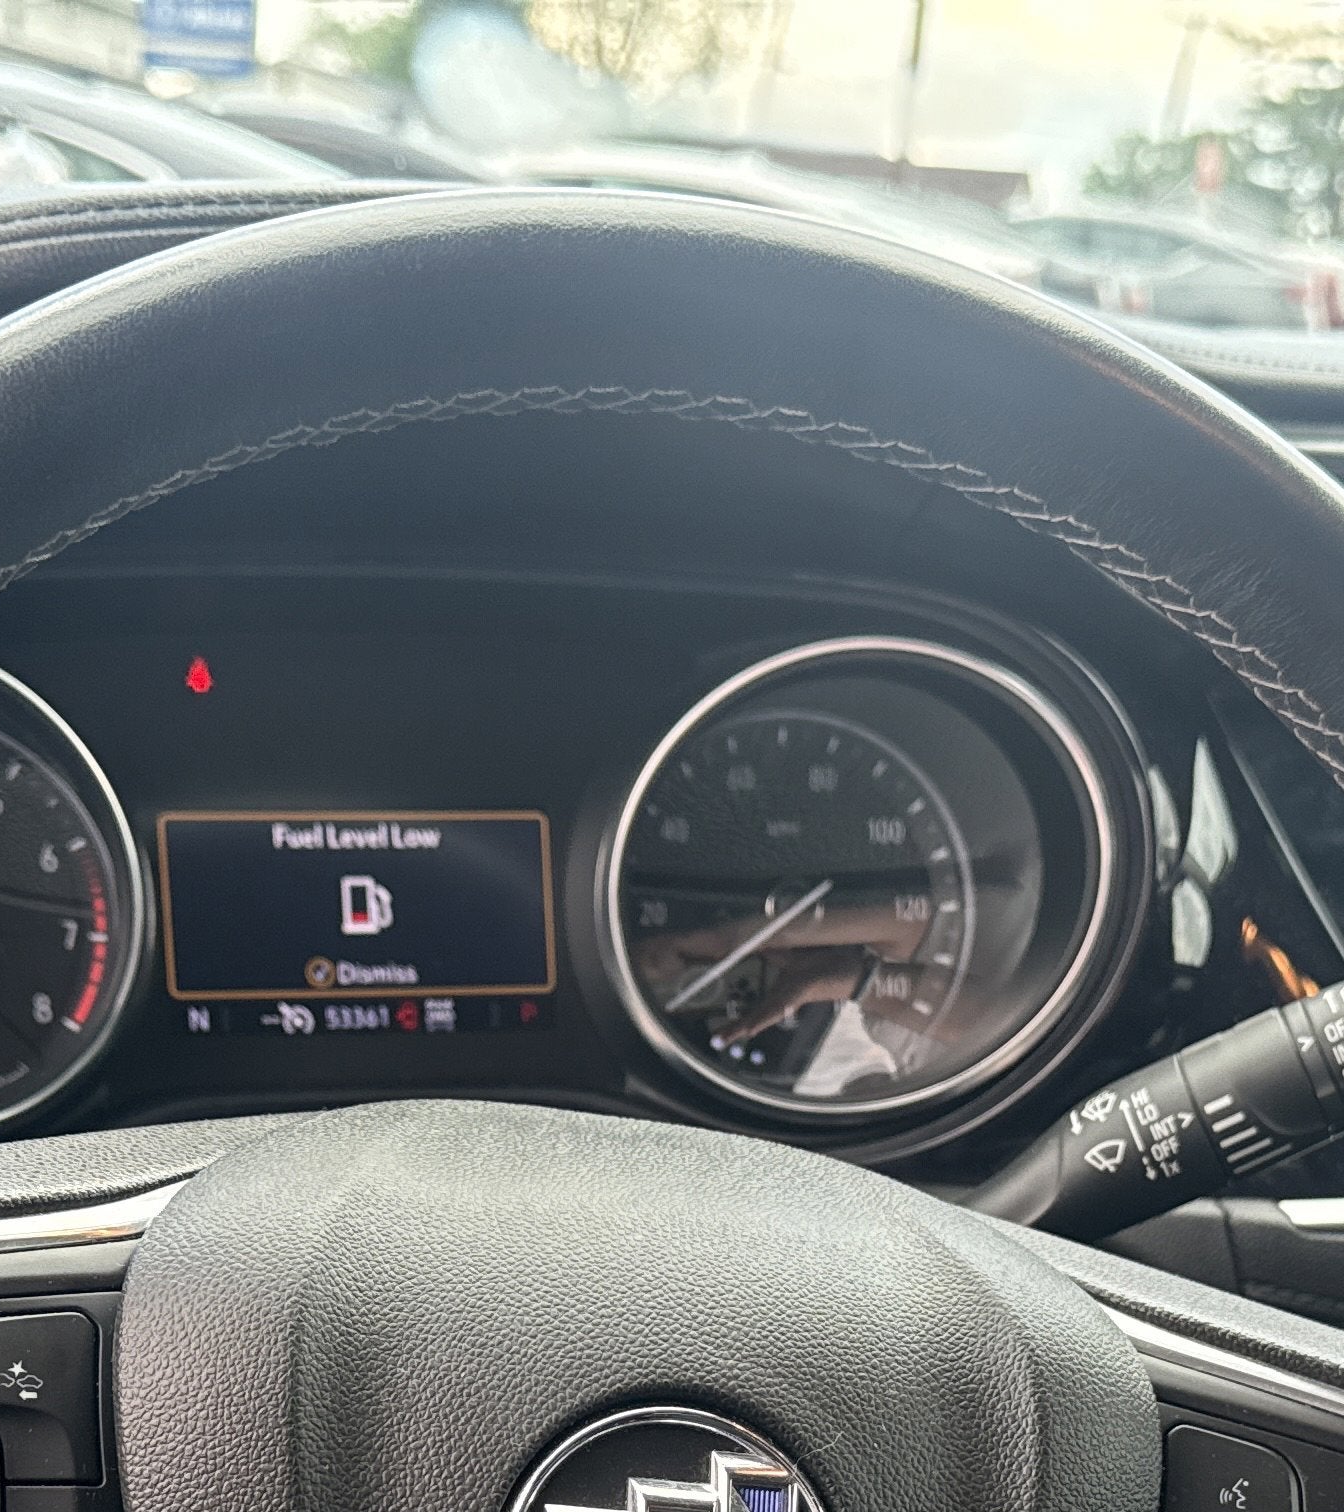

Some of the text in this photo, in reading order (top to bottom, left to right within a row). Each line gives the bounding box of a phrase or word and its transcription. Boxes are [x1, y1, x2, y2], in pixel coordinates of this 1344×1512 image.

[272, 821, 442, 850] Fuel Level Low
[867, 816, 906, 845] 100
[40, 844, 58, 873] 6
[894, 894, 928, 922] 120
[61, 919, 79, 950] 7
[337, 960, 418, 986] Dismiss
[875, 973, 911, 999] 140
[32, 992, 53, 1024] 8
[187, 1004, 210, 1033] N
[1130, 1087, 1150, 1109] HI
[1135, 1103, 1159, 1126] LO
[1149, 1114, 1178, 1141] INT
[1150, 1134, 1180, 1162] OFF
